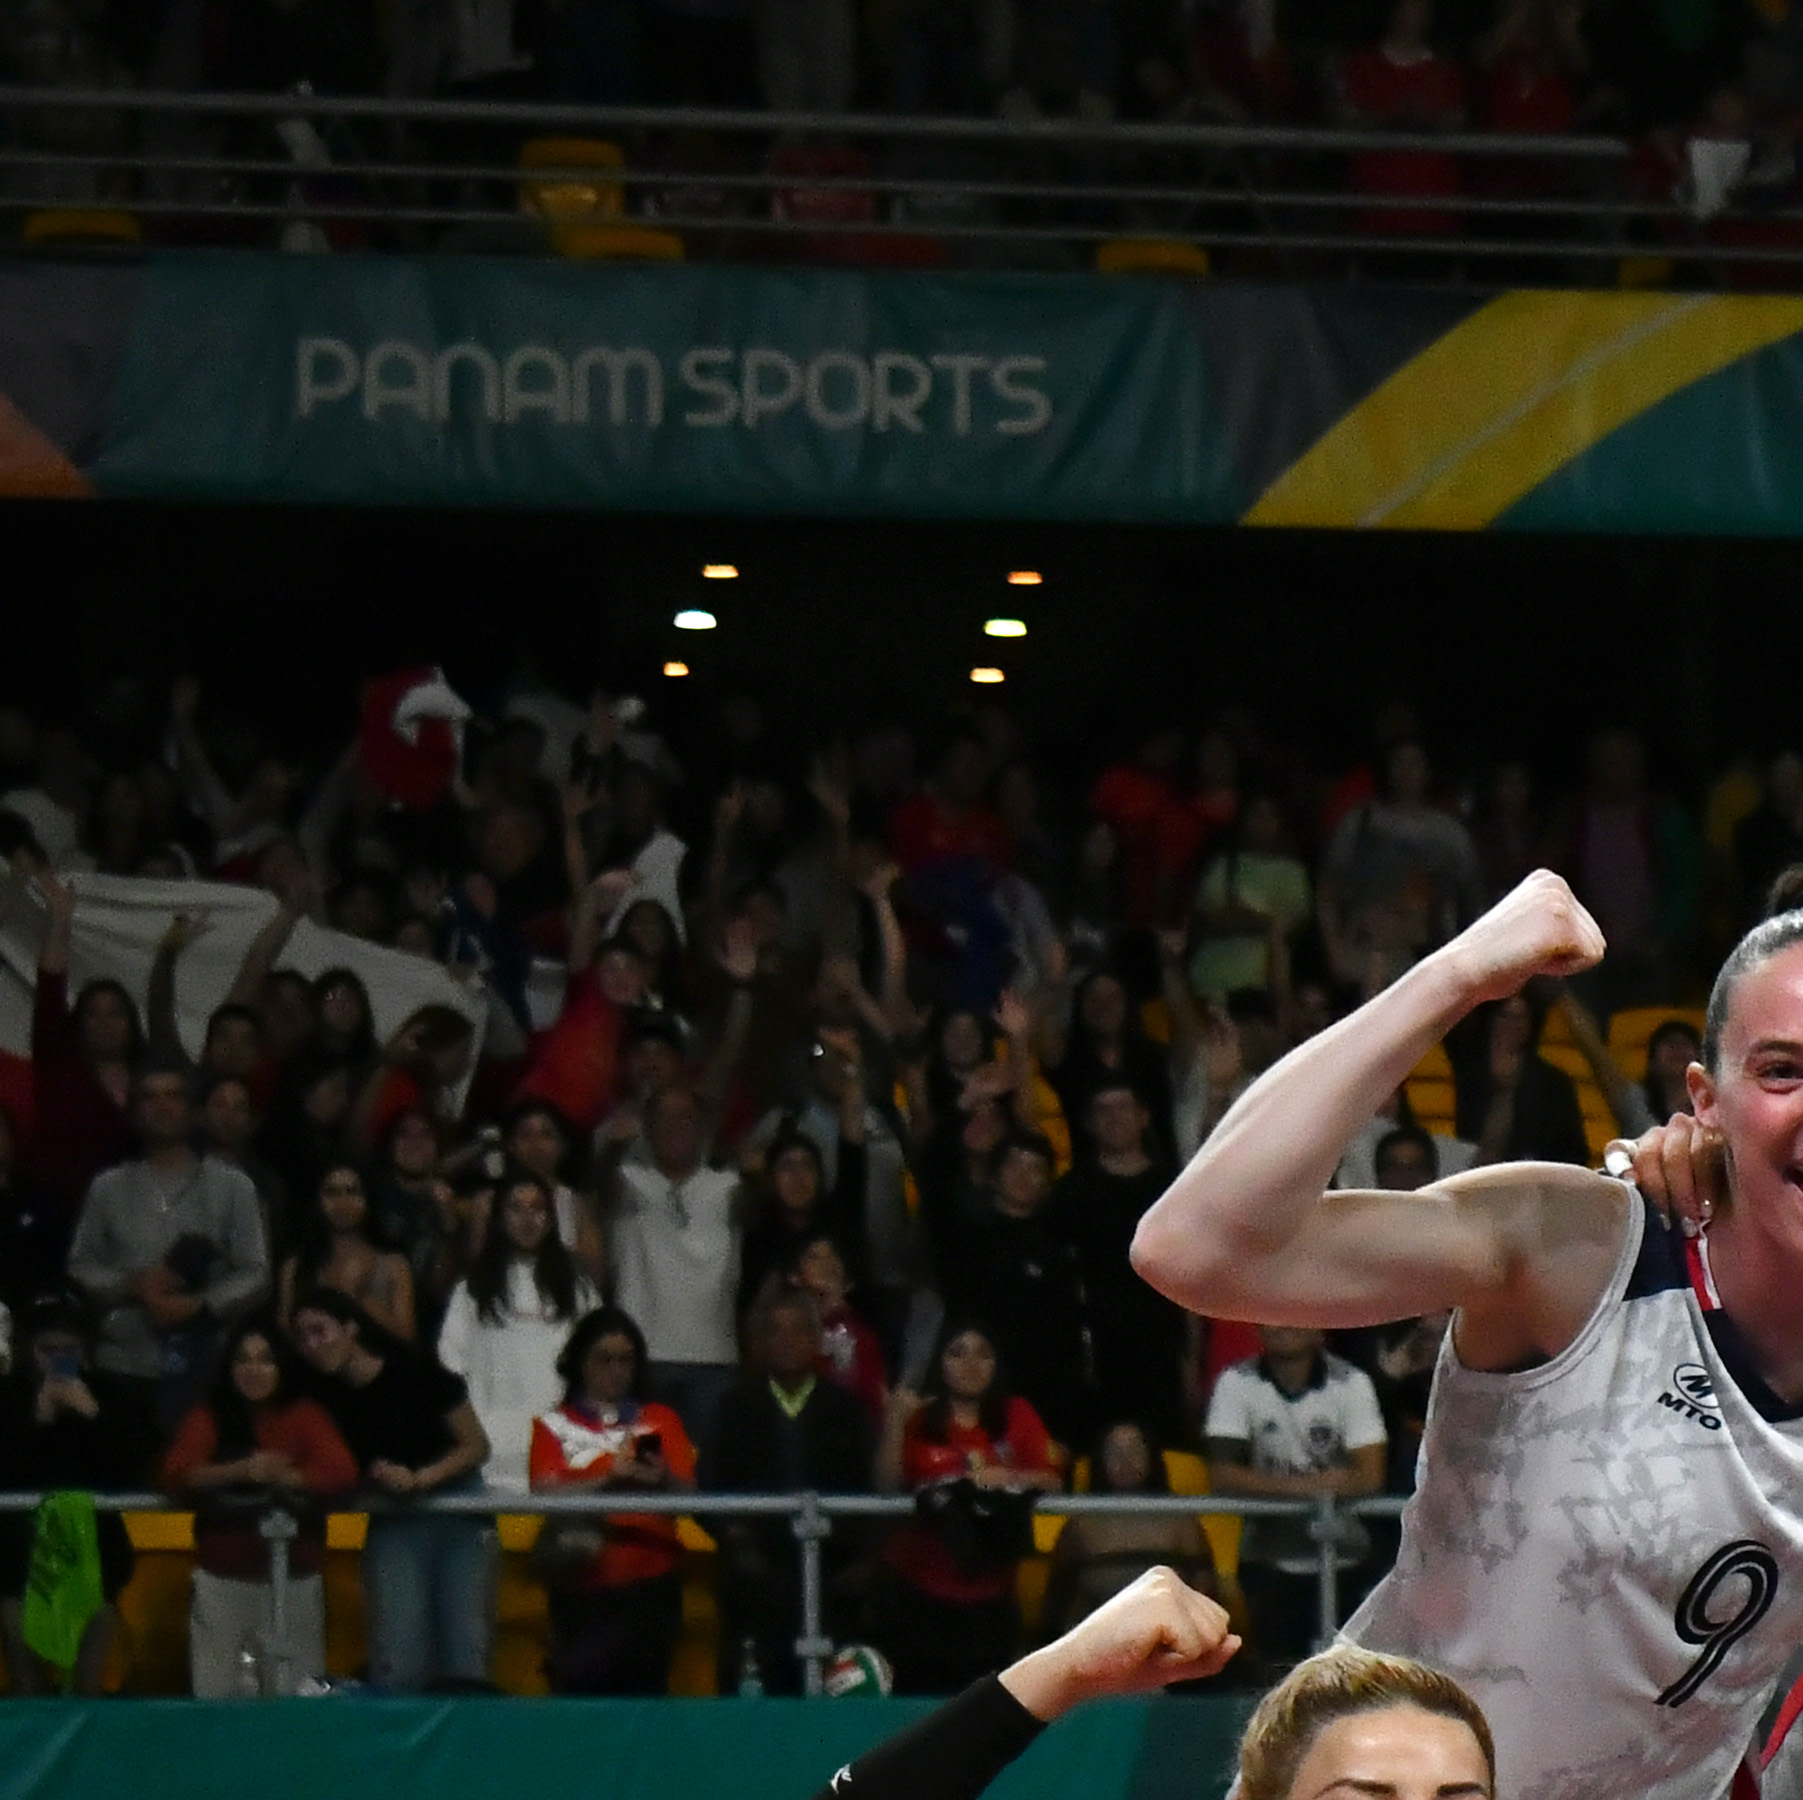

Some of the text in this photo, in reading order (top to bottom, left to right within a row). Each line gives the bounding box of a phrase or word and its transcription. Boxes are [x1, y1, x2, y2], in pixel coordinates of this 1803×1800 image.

[299, 338, 1053, 435] PANAM SPORTS
[1658, 1391, 1722, 1431] MTO
[1654, 1539, 1778, 1707] 9
